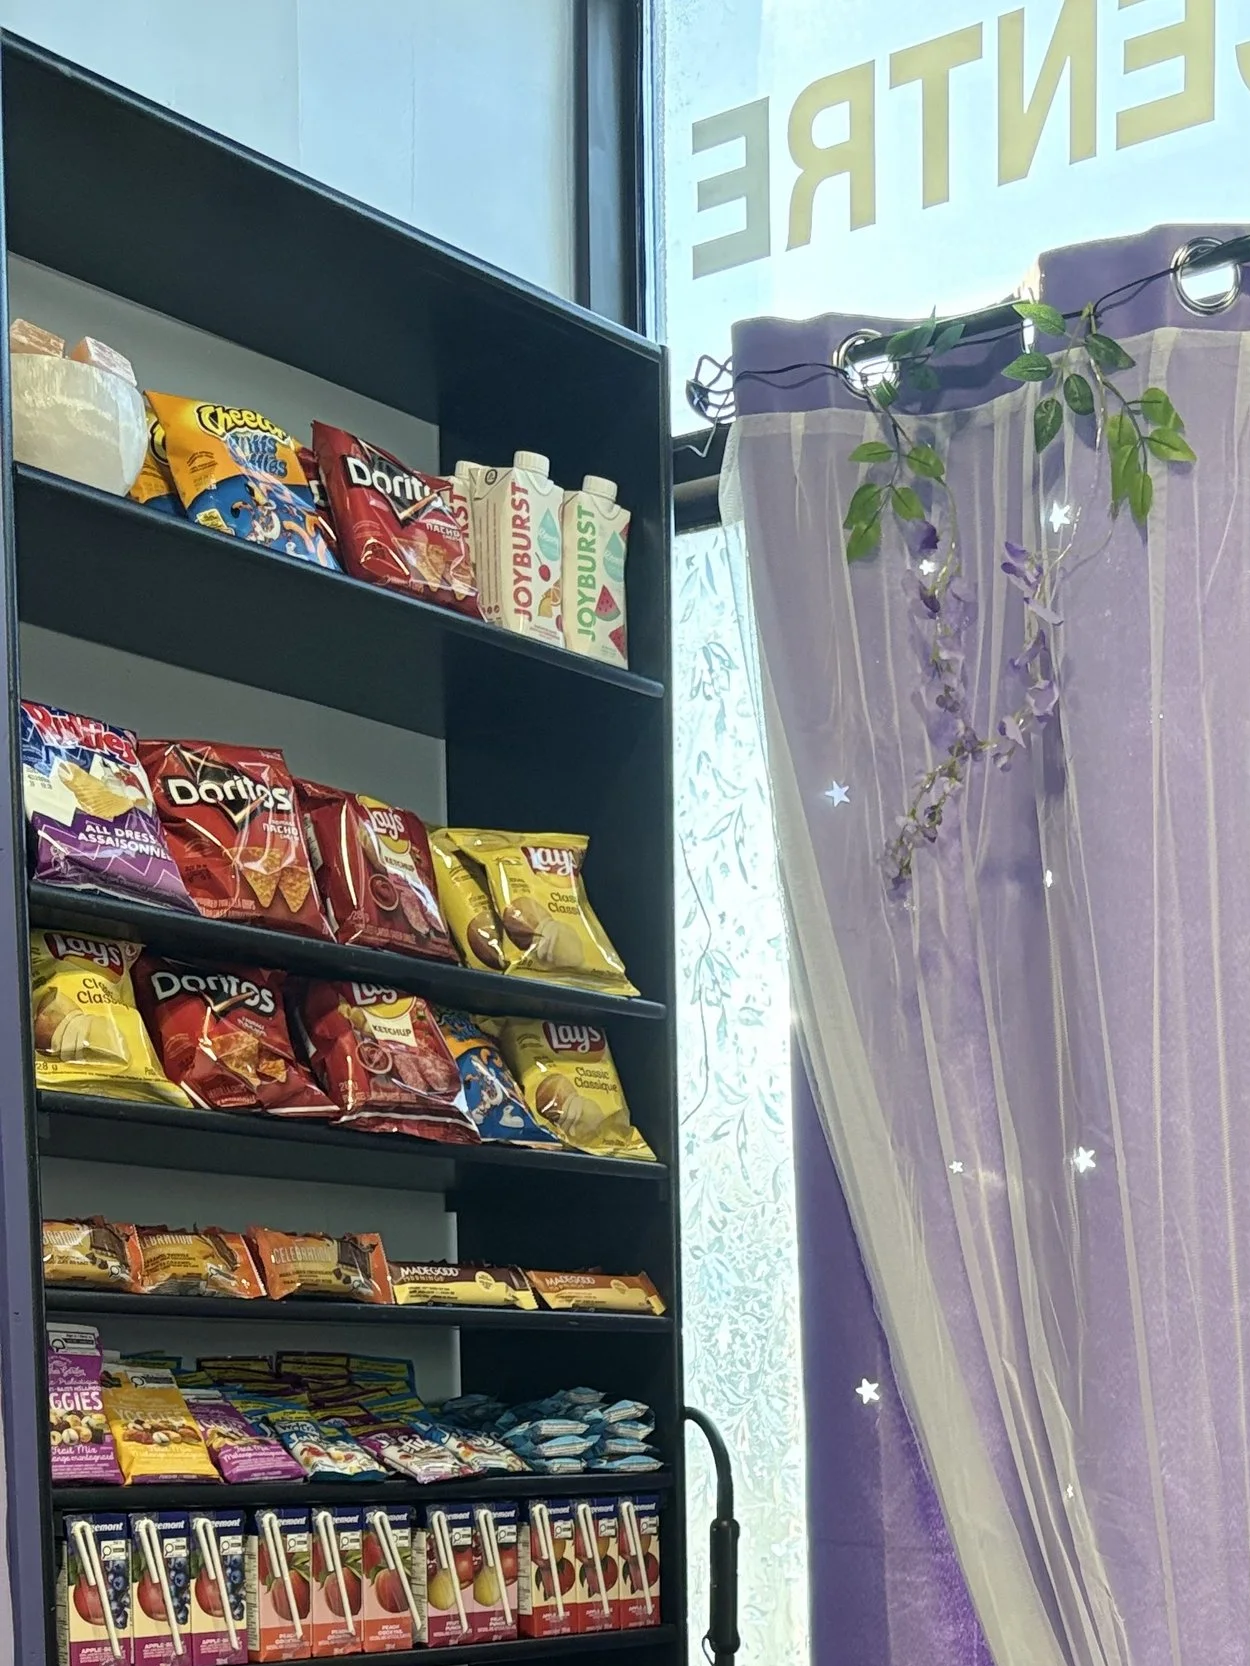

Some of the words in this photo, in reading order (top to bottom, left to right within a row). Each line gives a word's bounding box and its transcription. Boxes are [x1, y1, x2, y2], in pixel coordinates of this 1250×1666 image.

[346, 456, 431, 501] Dorit
[511, 482, 534, 623] JOYBURST
[576, 504, 598, 643] JOYBURST
[167, 775, 292, 811] Doritos
[85, 823, 111, 836] ALL
[114, 828, 157, 845] DRESS
[52, 933, 121, 967] Lays
[150, 971, 276, 1014] Doritos
[371, 1024, 413, 1038] KETCHUP
[549, 1022, 601, 1053] Lays
[574, 1076, 618, 1094] Classique
[575, 1066, 610, 1081] Classic
[49, 1391, 104, 1411] GGIES
